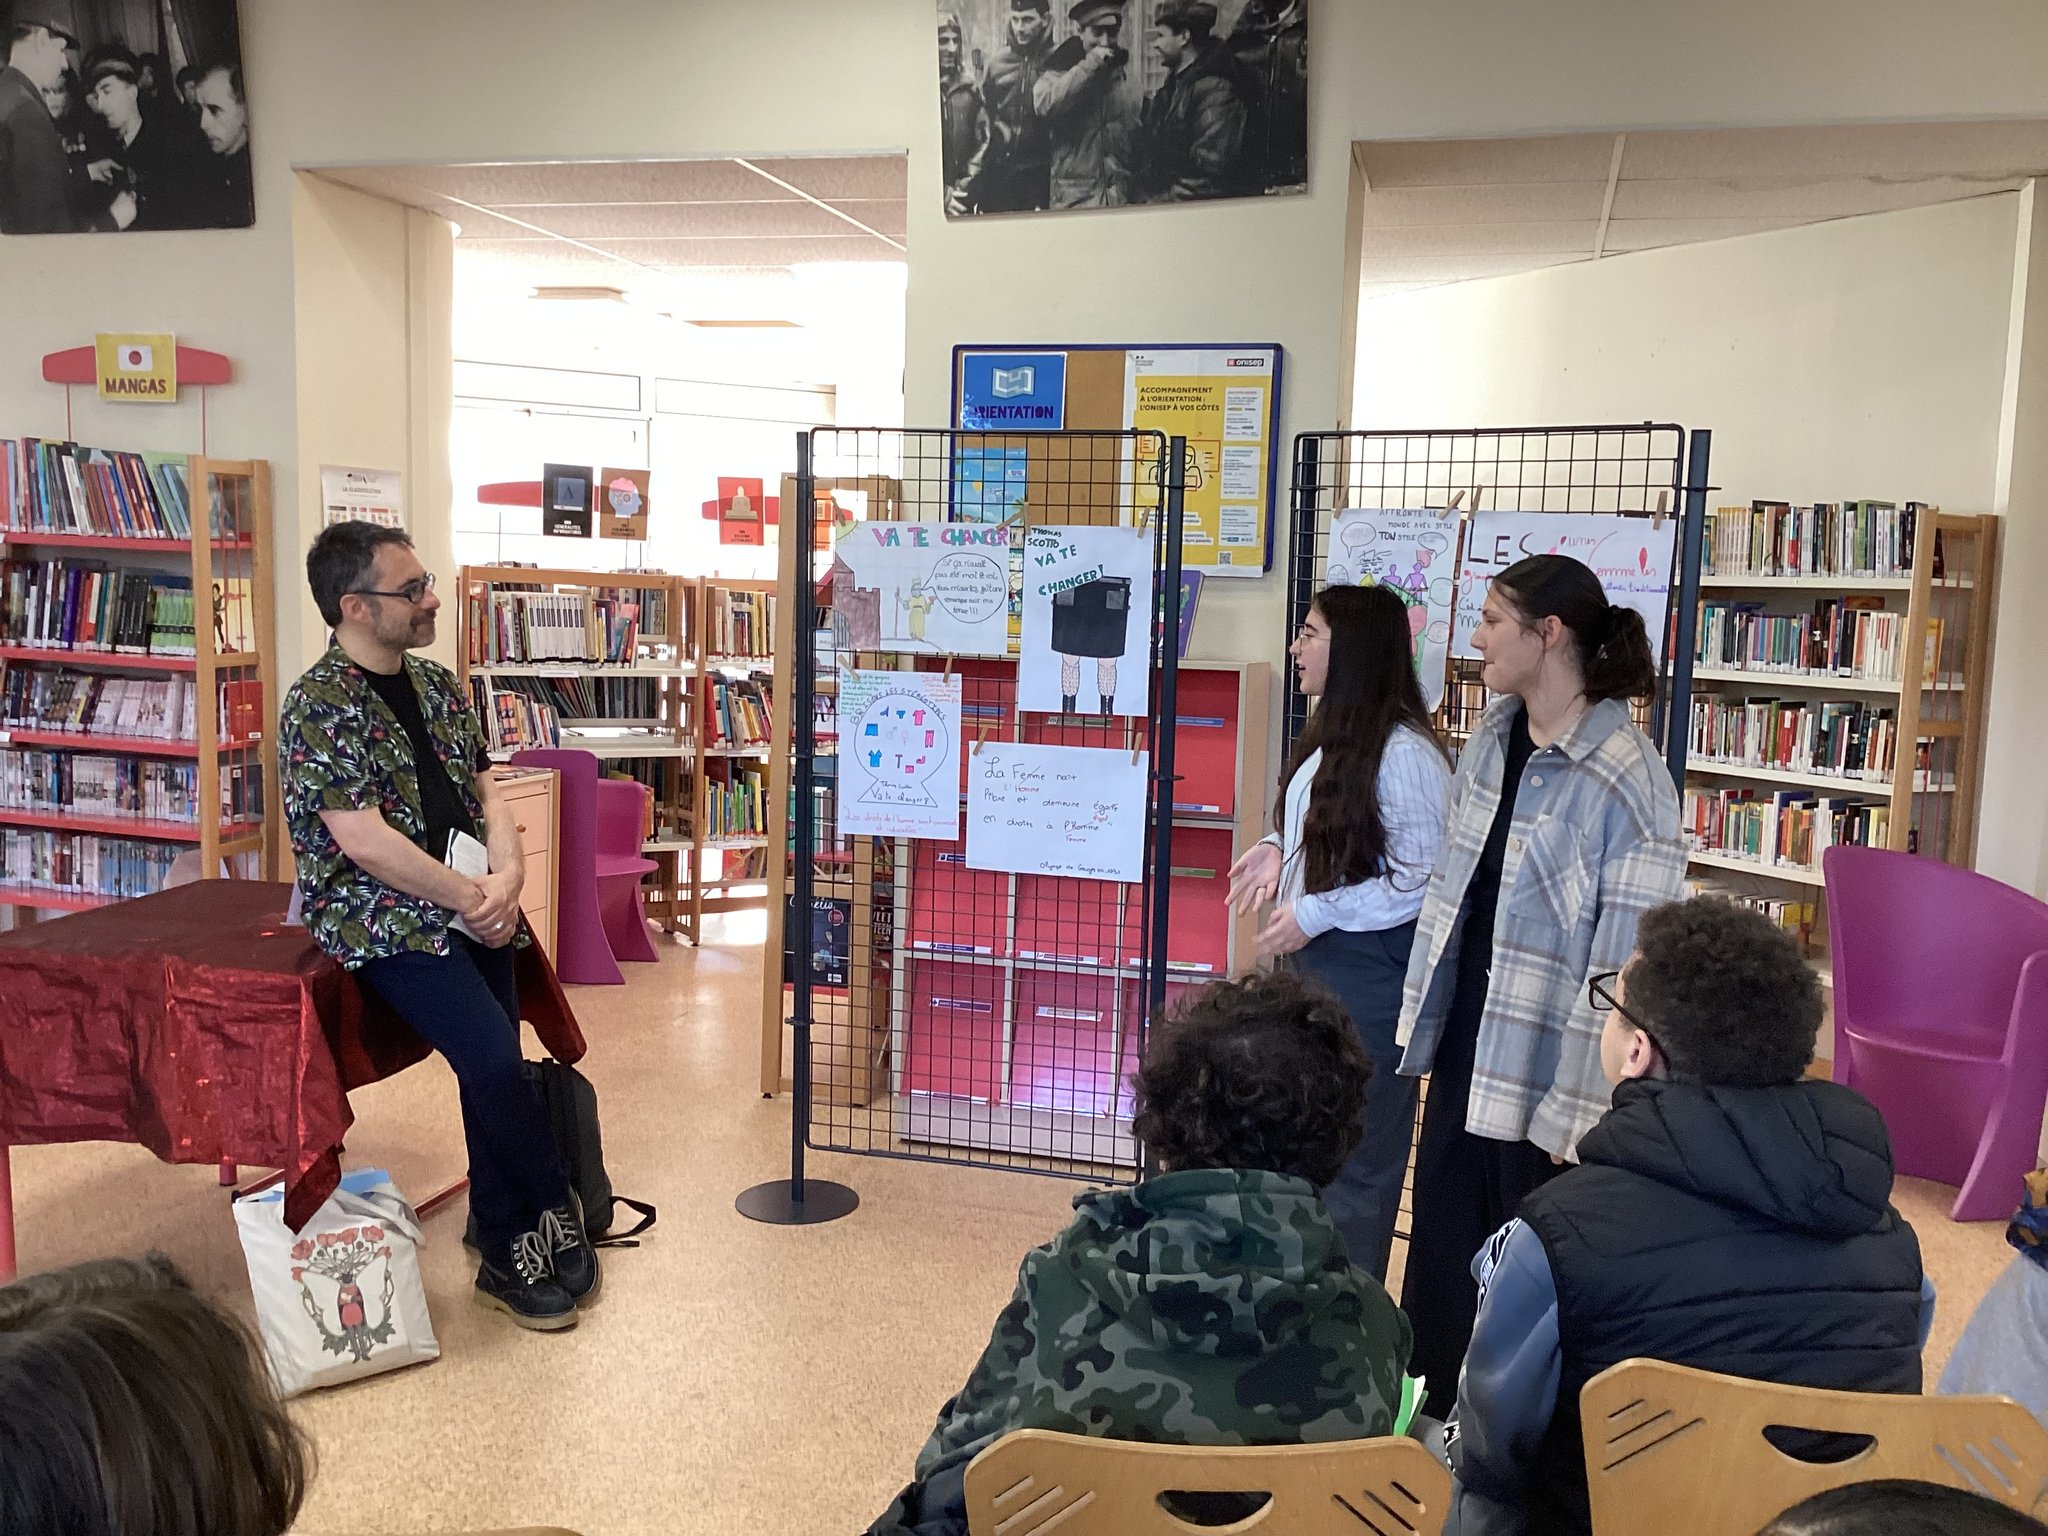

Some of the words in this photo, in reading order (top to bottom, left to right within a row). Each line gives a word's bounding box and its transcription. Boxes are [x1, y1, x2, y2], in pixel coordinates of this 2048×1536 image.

[1235, 359, 1263, 367] onisep
[105, 377, 167, 394] MANGAS
[1140, 386, 1213, 394] ACCOMPAGNEMENT
[1147, 395, 1202, 403] L'ORIENTATION
[1172, 403, 1179, 411] À
[1196, 403, 1220, 411] CÔTÉS
[1379, 508, 1421, 518] AFFRONTE
[1428, 510, 1437, 518] LE
[1388, 521, 1410, 529] MONDE
[872, 526, 900, 547] VA
[907, 526, 929, 547] TE
[1031, 527, 1062, 538] THOMAS
[1378, 531, 1397, 541] TON
[1027, 537, 1060, 548] SCOTTO
[1034, 552, 1057, 568] VA
[1059, 544, 1077, 560] TE
[962, 571, 978, 579] moi
[984, 756, 1005, 779] La
[1013, 763, 1046, 782] Femme
[870, 787, 883, 801] Va
[1042, 799, 1080, 808] demeure
[983, 814, 997, 823] en
[1007, 818, 1033, 828] droits
[1046, 821, 1053, 829] à
[1065, 834, 1087, 843] Femme
